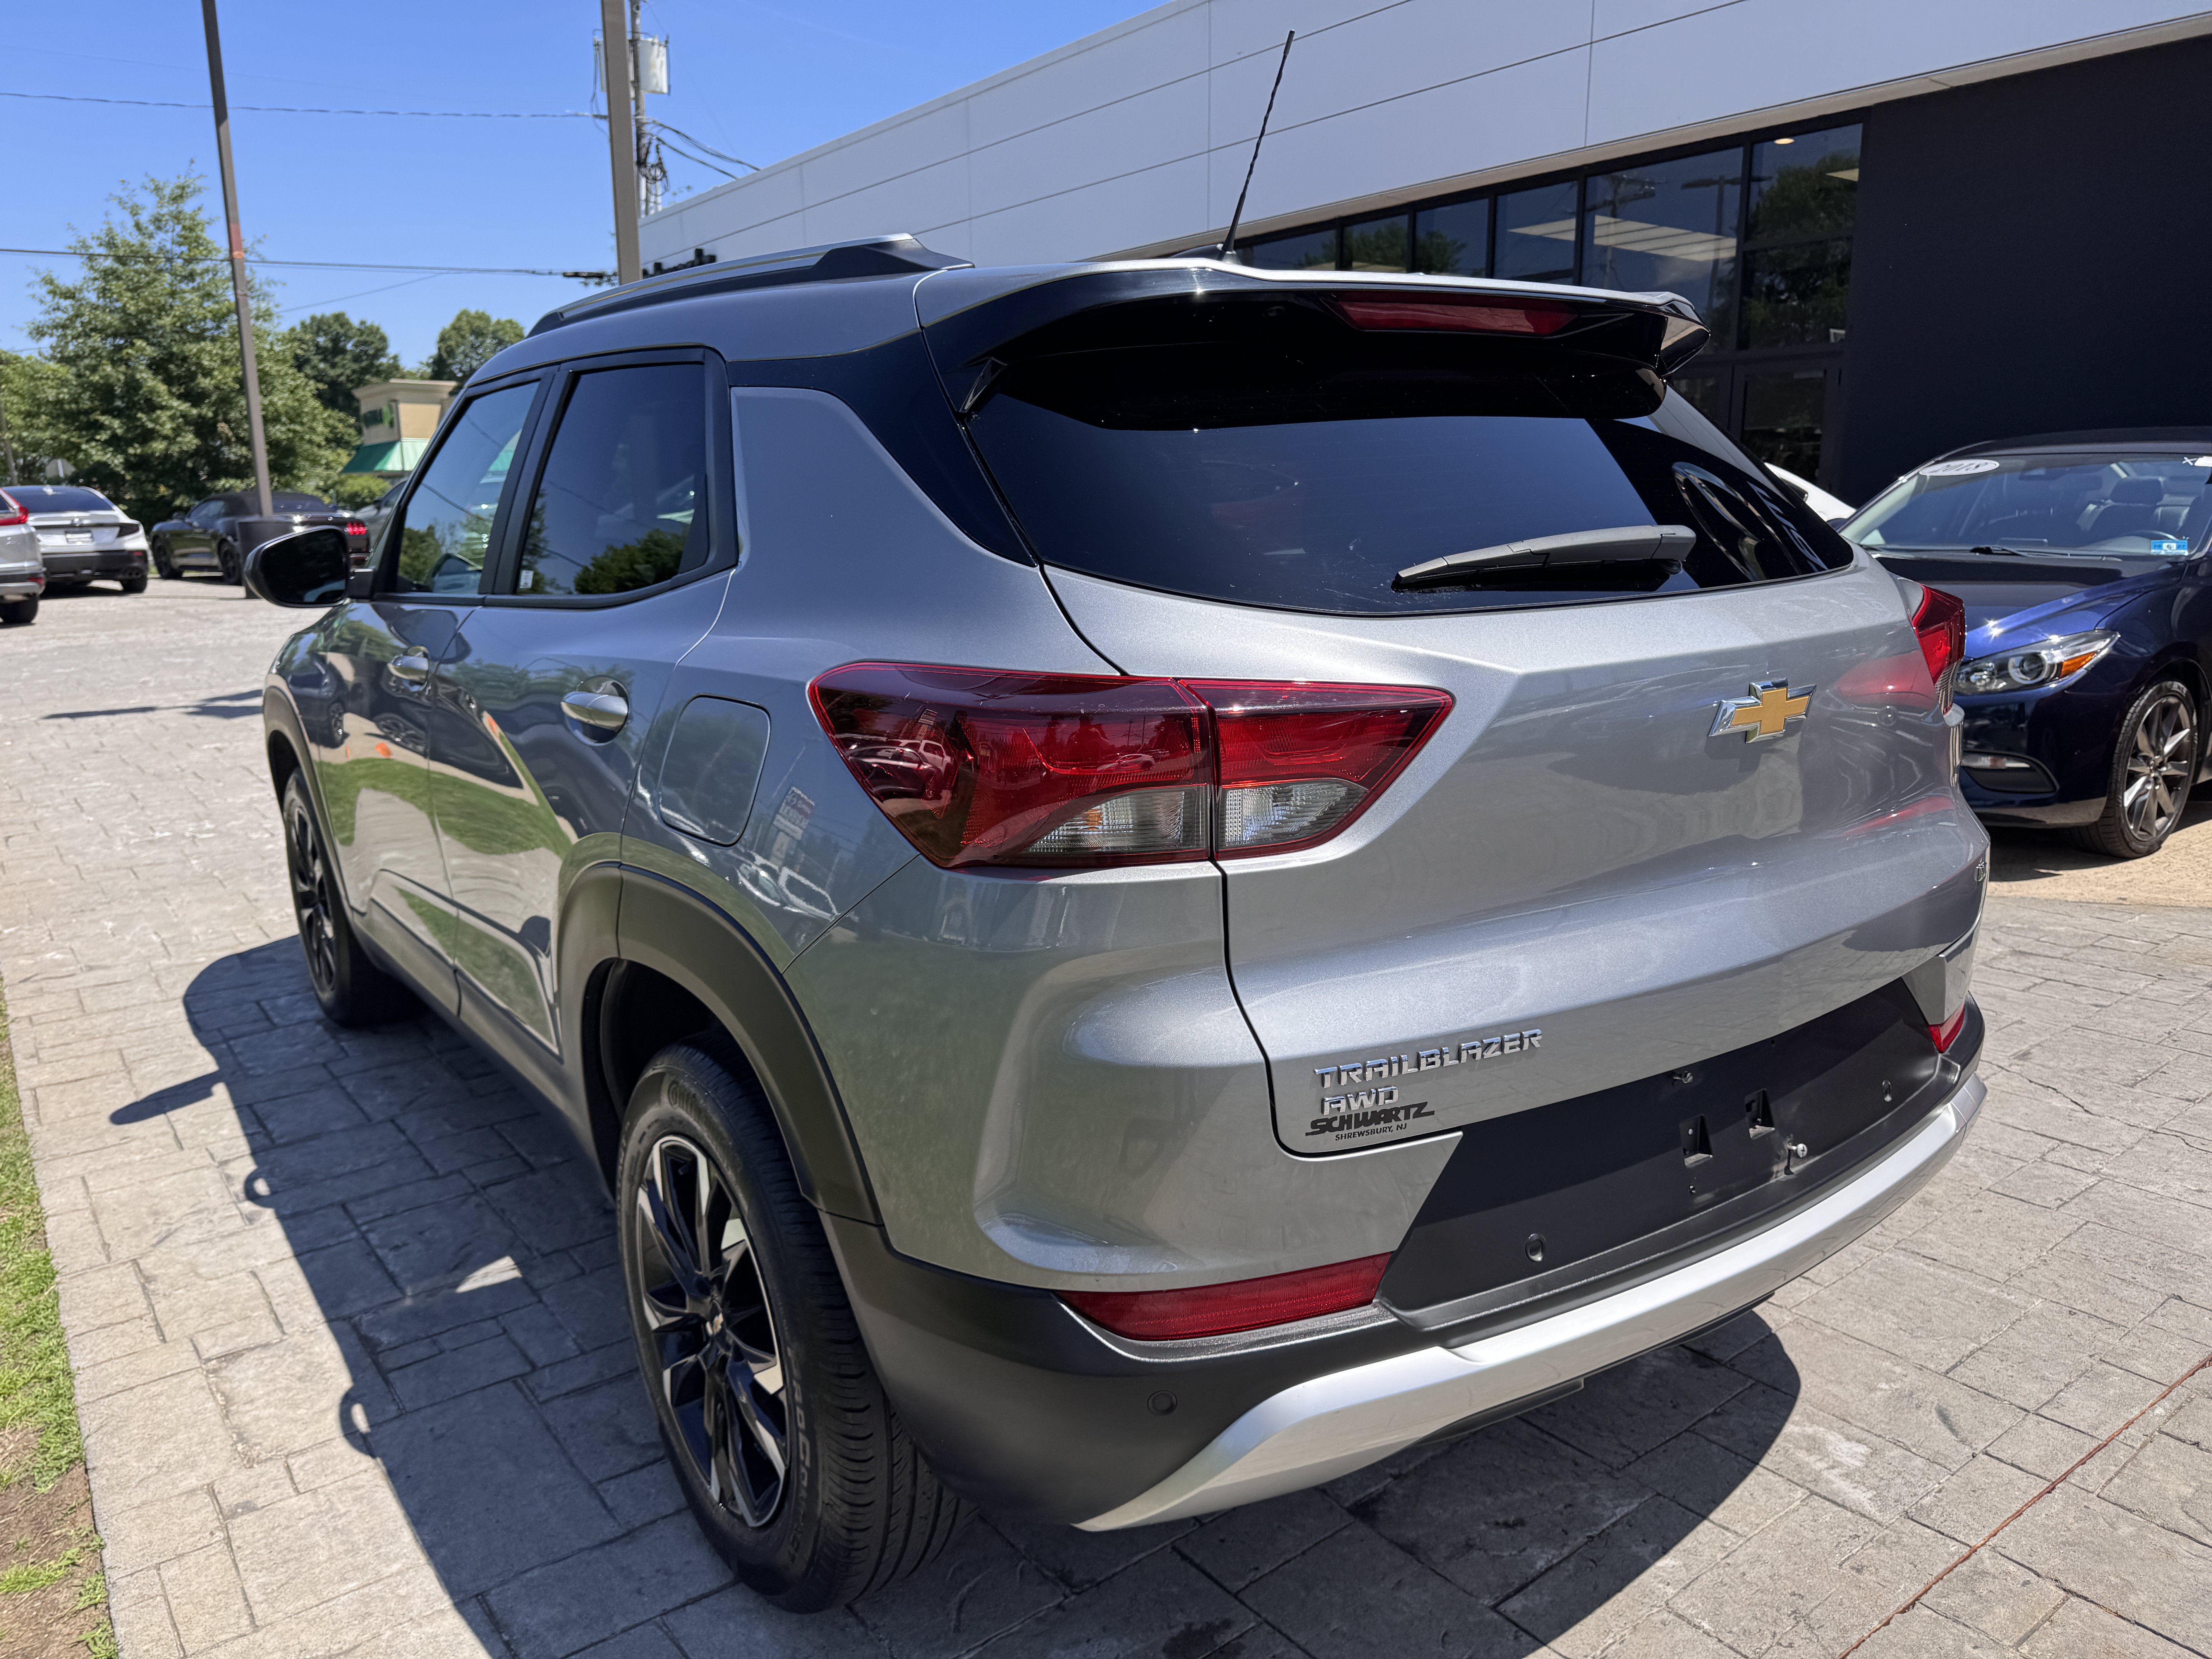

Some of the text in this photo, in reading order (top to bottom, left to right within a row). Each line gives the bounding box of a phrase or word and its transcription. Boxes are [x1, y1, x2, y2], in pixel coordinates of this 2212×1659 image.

[1928, 462, 1989, 474] 2018
[1314, 1029, 1542, 1089] TRAILBLAZER
[1321, 1085, 1399, 1116] AWD
[1305, 1101, 1435, 1137] SCHWARTZ
[1335, 1125, 1393, 1141] SHREWSBURY,
